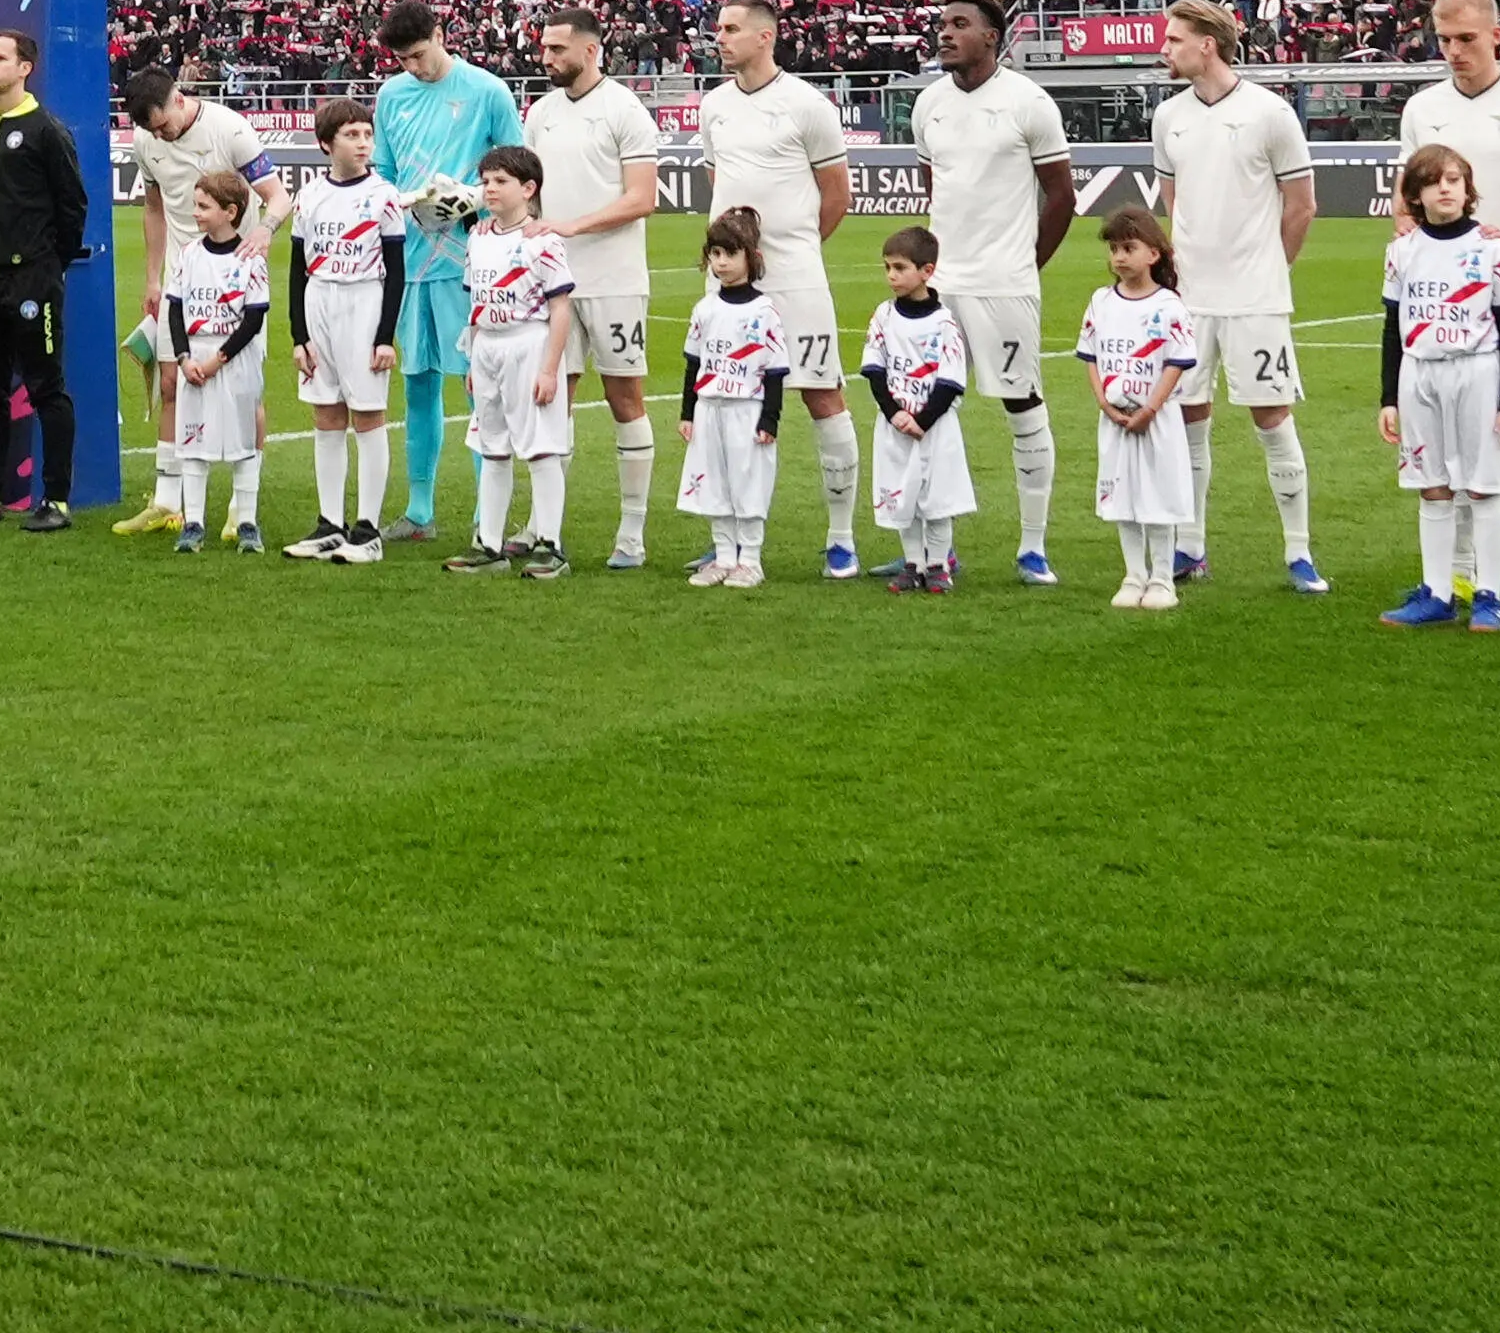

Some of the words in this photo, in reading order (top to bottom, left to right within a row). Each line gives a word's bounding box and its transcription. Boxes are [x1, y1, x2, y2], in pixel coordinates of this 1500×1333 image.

[1103, 23, 1155, 45] MALTA
[878, 166, 926, 194] SAL
[331, 260, 360, 274] OUT
[1409, 282, 1449, 298] KEEP
[1408, 304, 1470, 322] RACISM
[609, 320, 645, 353] 34
[1436, 327, 1471, 345] OUT
[798, 334, 831, 367] 77
[1002, 341, 1020, 373] 7
[1254, 346, 1290, 381] 24
[716, 381, 744, 395] OUT
[1122, 378, 1152, 396] OUT
